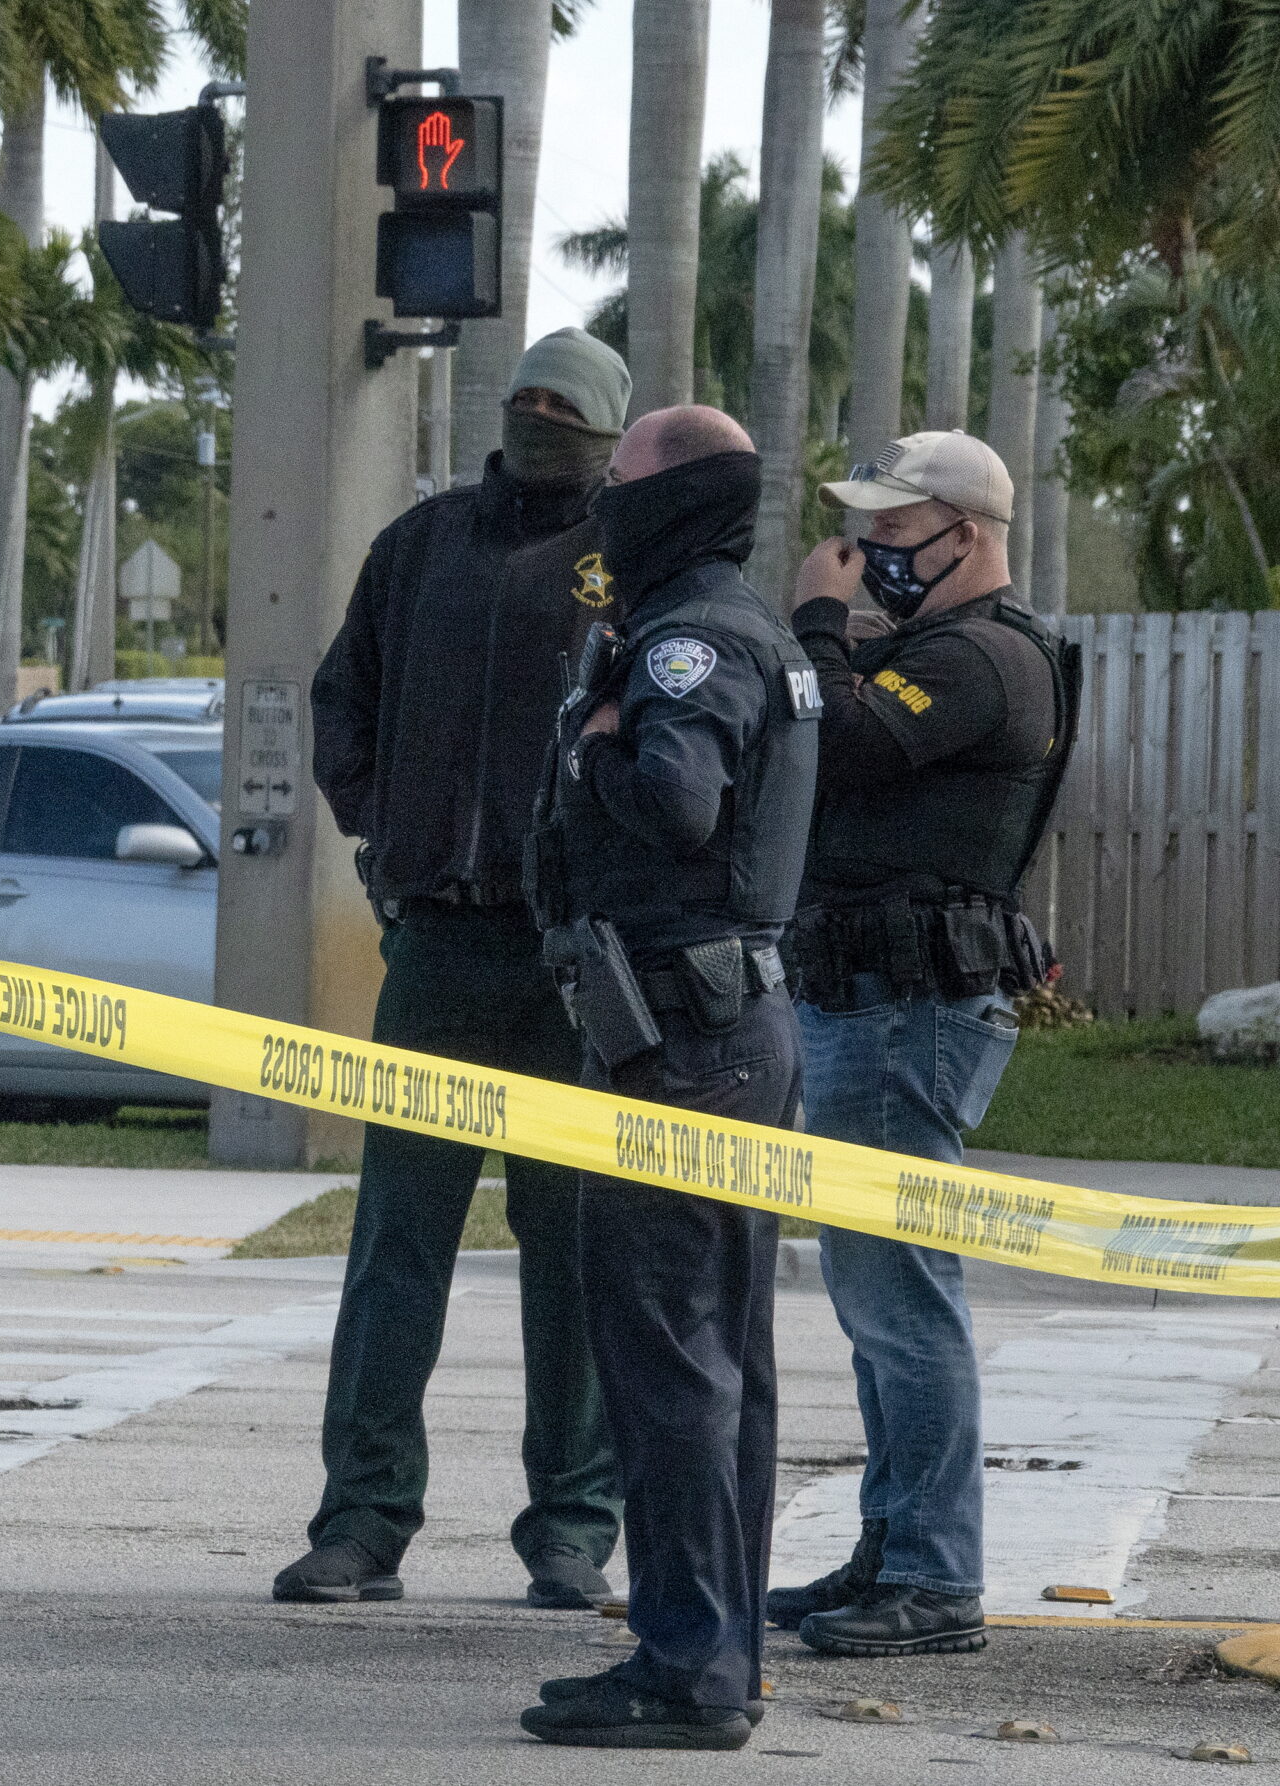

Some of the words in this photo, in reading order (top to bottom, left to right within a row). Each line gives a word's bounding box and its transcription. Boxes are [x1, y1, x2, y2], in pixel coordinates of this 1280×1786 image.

[653, 646, 710, 661] DEPARTMENT
[661, 641, 703, 651] POLICE
[654, 664, 666, 679] CITY
[663, 679, 675, 689] OF
[680, 664, 707, 690] SUNRISE
